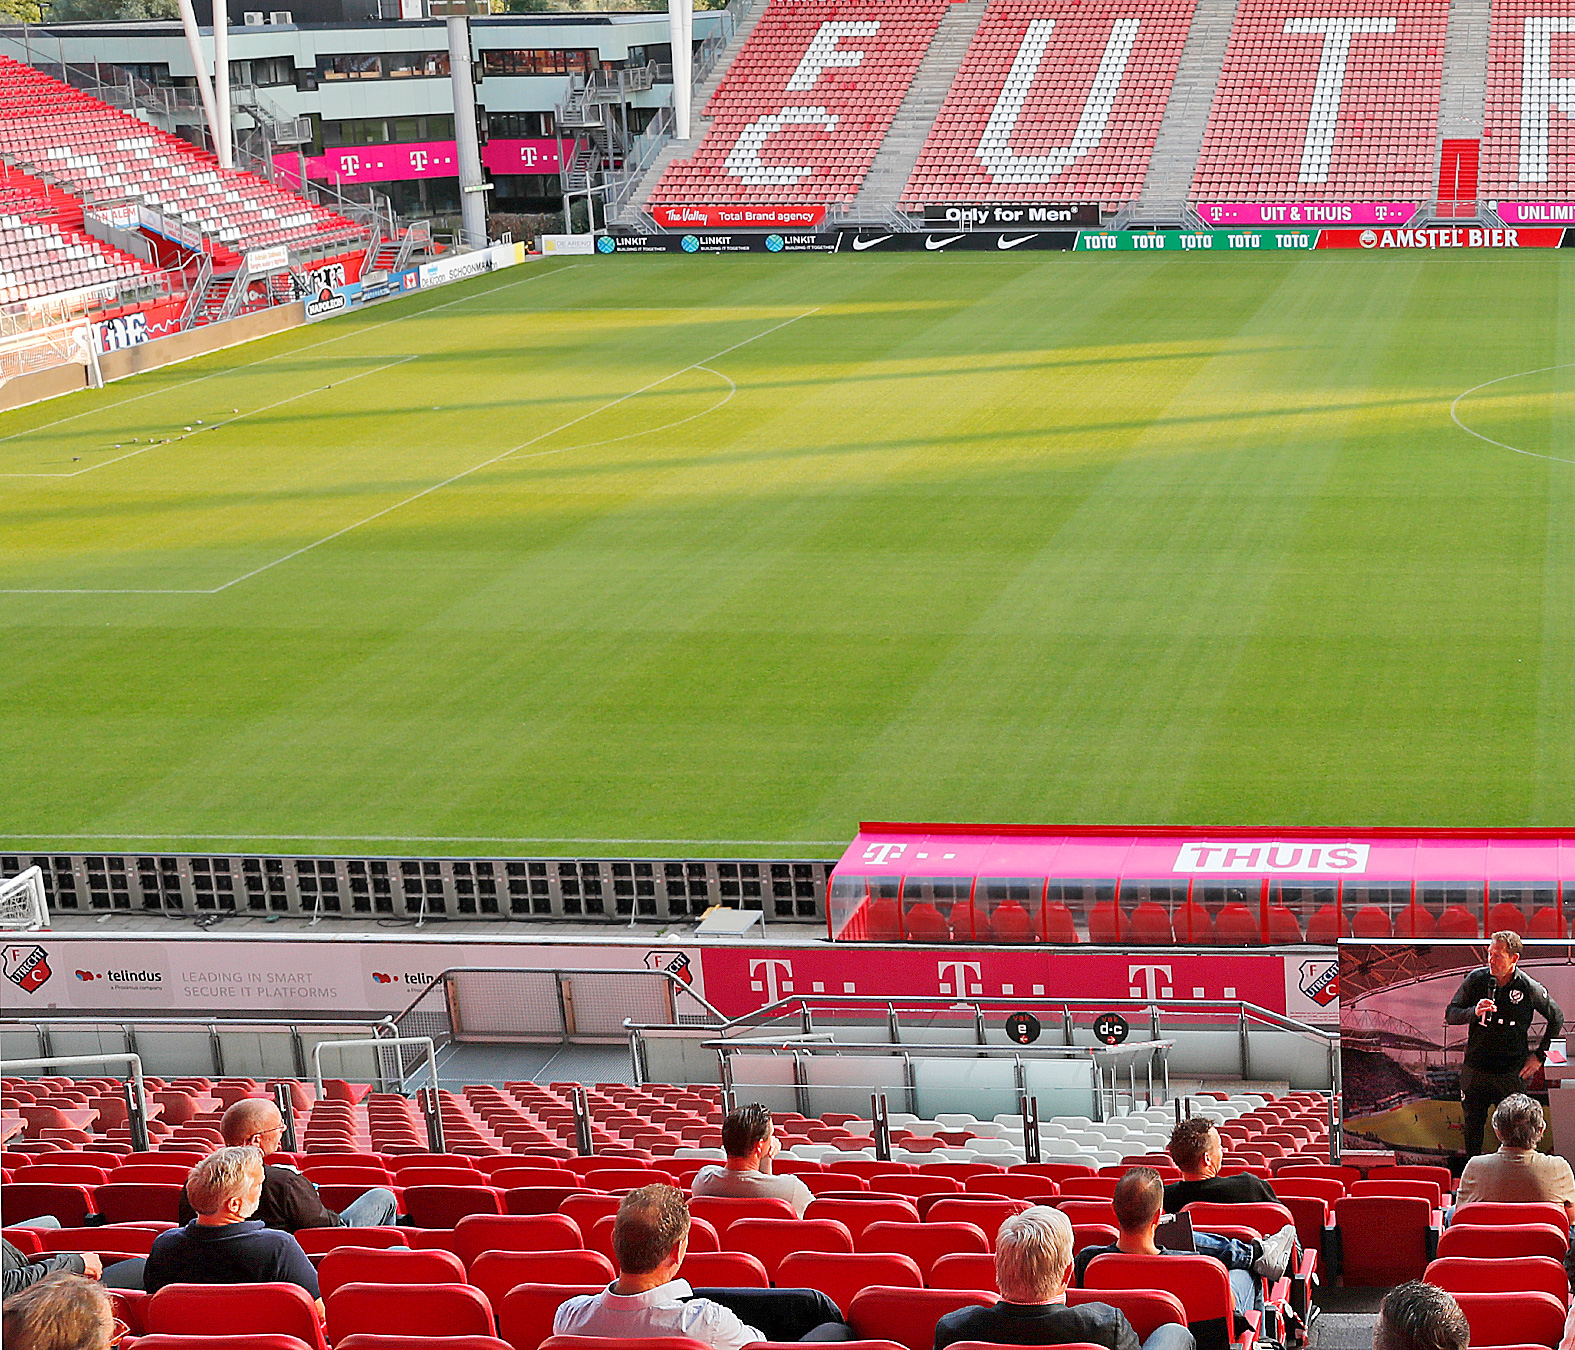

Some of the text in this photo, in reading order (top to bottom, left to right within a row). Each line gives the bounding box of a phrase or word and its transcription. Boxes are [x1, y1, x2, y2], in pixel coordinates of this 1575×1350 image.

[785, 20, 881, 92] F
[723, 106, 841, 186] C
[666, 208, 708, 225] The Valley
[719, 212, 814, 222] Total Brand agency
[946, 208, 989, 223] Only
[994, 208, 1023, 221] for
[1261, 207, 1352, 220] UIT & THUIS
[616, 238, 647, 246] LINKIT
[700, 237, 731, 245] LINKIT
[785, 236, 816, 244] LINKIT
[1084, 235, 1117, 249] TOTO
[1132, 235, 1165, 249] TOTO
[1180, 235, 1213, 249] TOTO
[1228, 235, 1261, 249] TOTO
[1276, 235, 1309, 249] TOTO
[1380, 229, 1463, 248] AMSTEL
[1469, 230, 1519, 247] BIER
[308, 297, 344, 315] NAPOLEON
[1191, 847, 1357, 868] THUIS
[11, 950, 20, 962] F
[655, 955, 662, 967] F
[11, 949, 45, 983] UTRECHT
[1309, 964, 1317, 976] F
[31, 970, 43, 982] C
[107, 970, 162, 982] telindus
[182, 972, 312, 984] LEADING IN SMART
[184, 987, 337, 998] SECURE IT PLATFORMS
[1325, 984, 1337, 995] C
[1018, 1024, 1027, 1033] e
